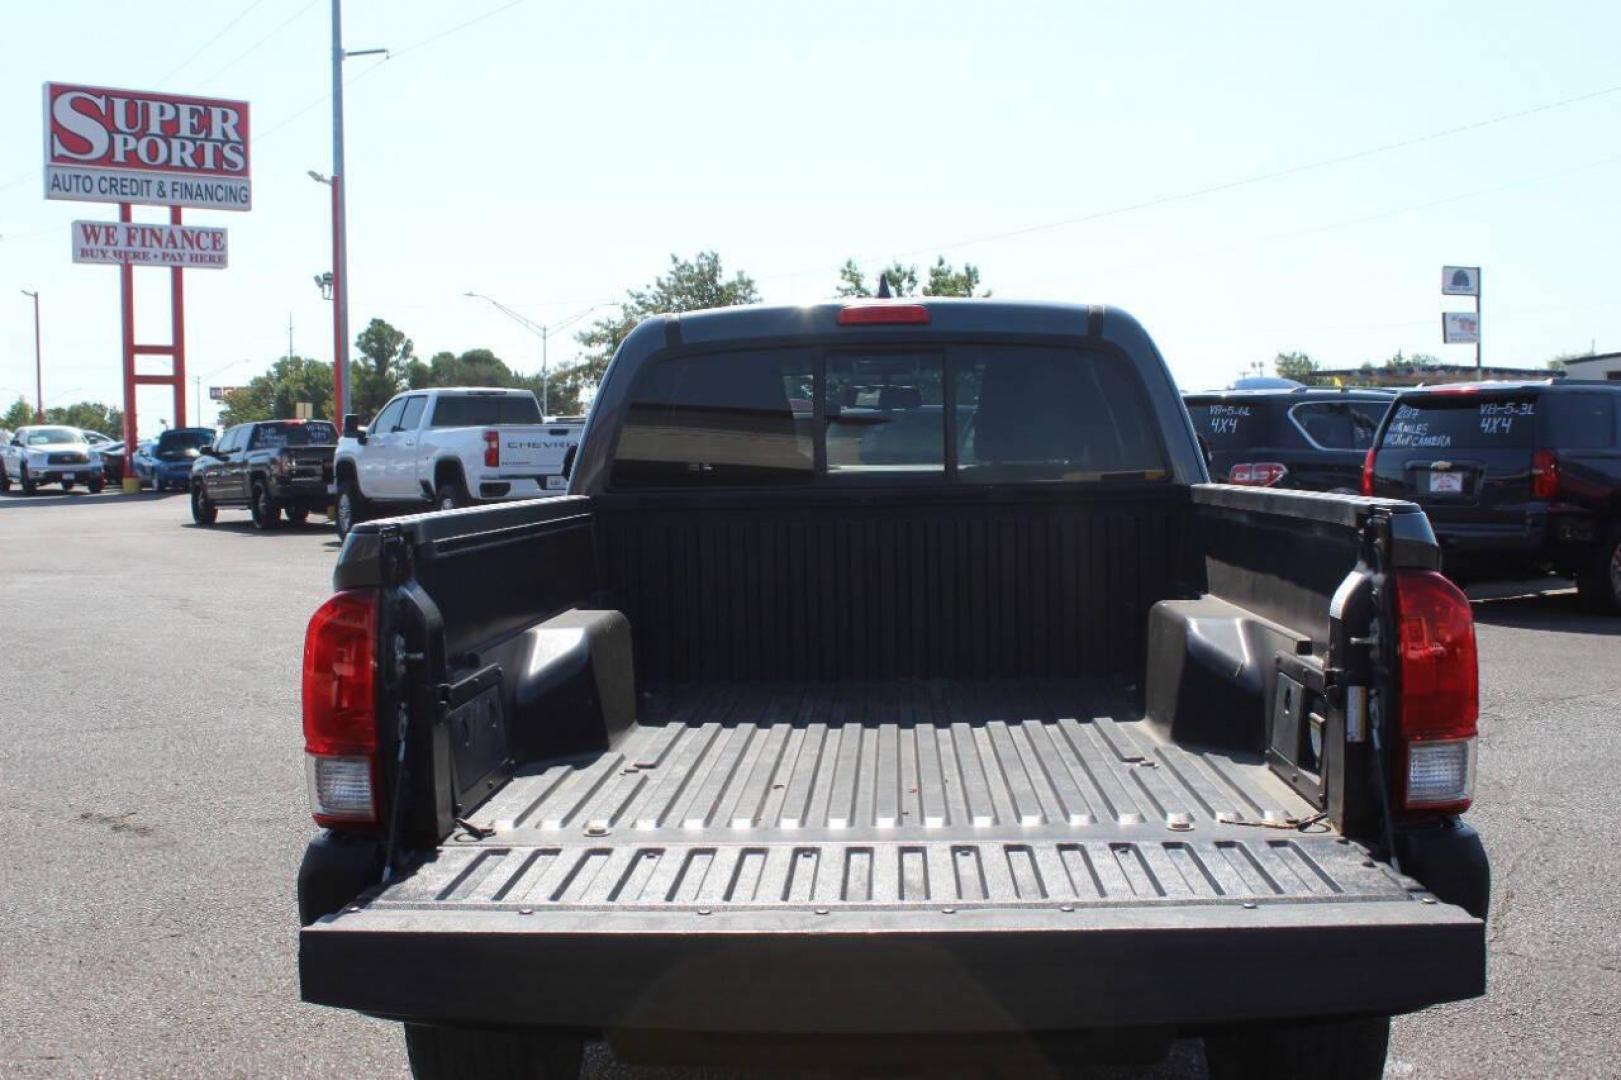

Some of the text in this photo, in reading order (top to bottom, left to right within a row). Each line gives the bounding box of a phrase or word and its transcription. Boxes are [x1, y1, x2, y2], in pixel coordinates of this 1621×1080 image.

[52, 91, 243, 161] SUPER
[50, 172, 249, 204] AUTO CREDIT & FINANCING
[80, 222, 226, 252] WE FINANCE
[79, 247, 226, 265] BUY HERE PAY HERE
